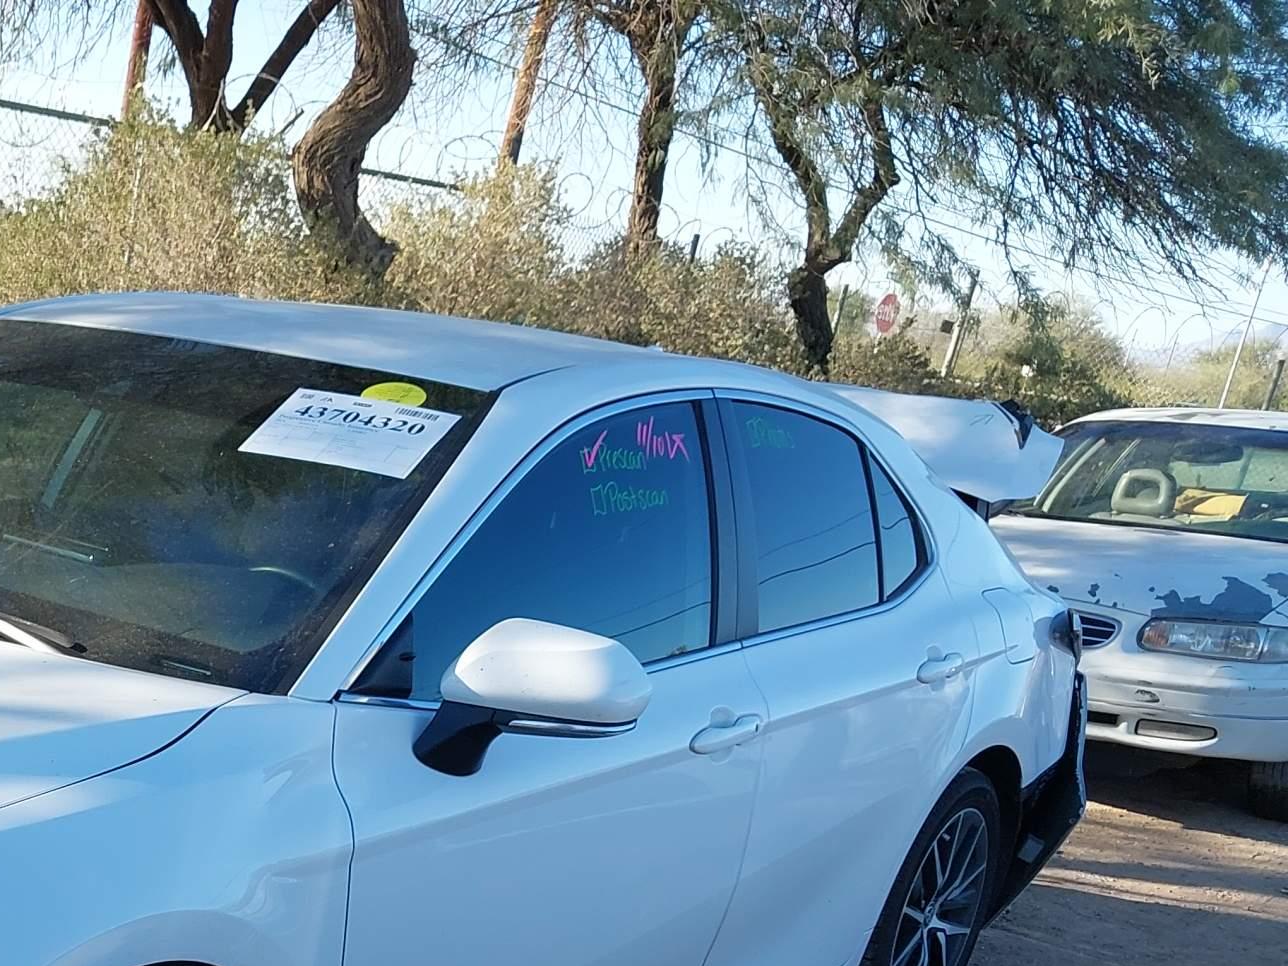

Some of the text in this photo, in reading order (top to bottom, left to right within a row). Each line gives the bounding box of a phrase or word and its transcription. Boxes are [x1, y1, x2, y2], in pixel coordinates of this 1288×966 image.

[295, 404, 426, 436] 43704320
[598, 442, 648, 471] Prescan
[605, 481, 668, 513] Postscan
